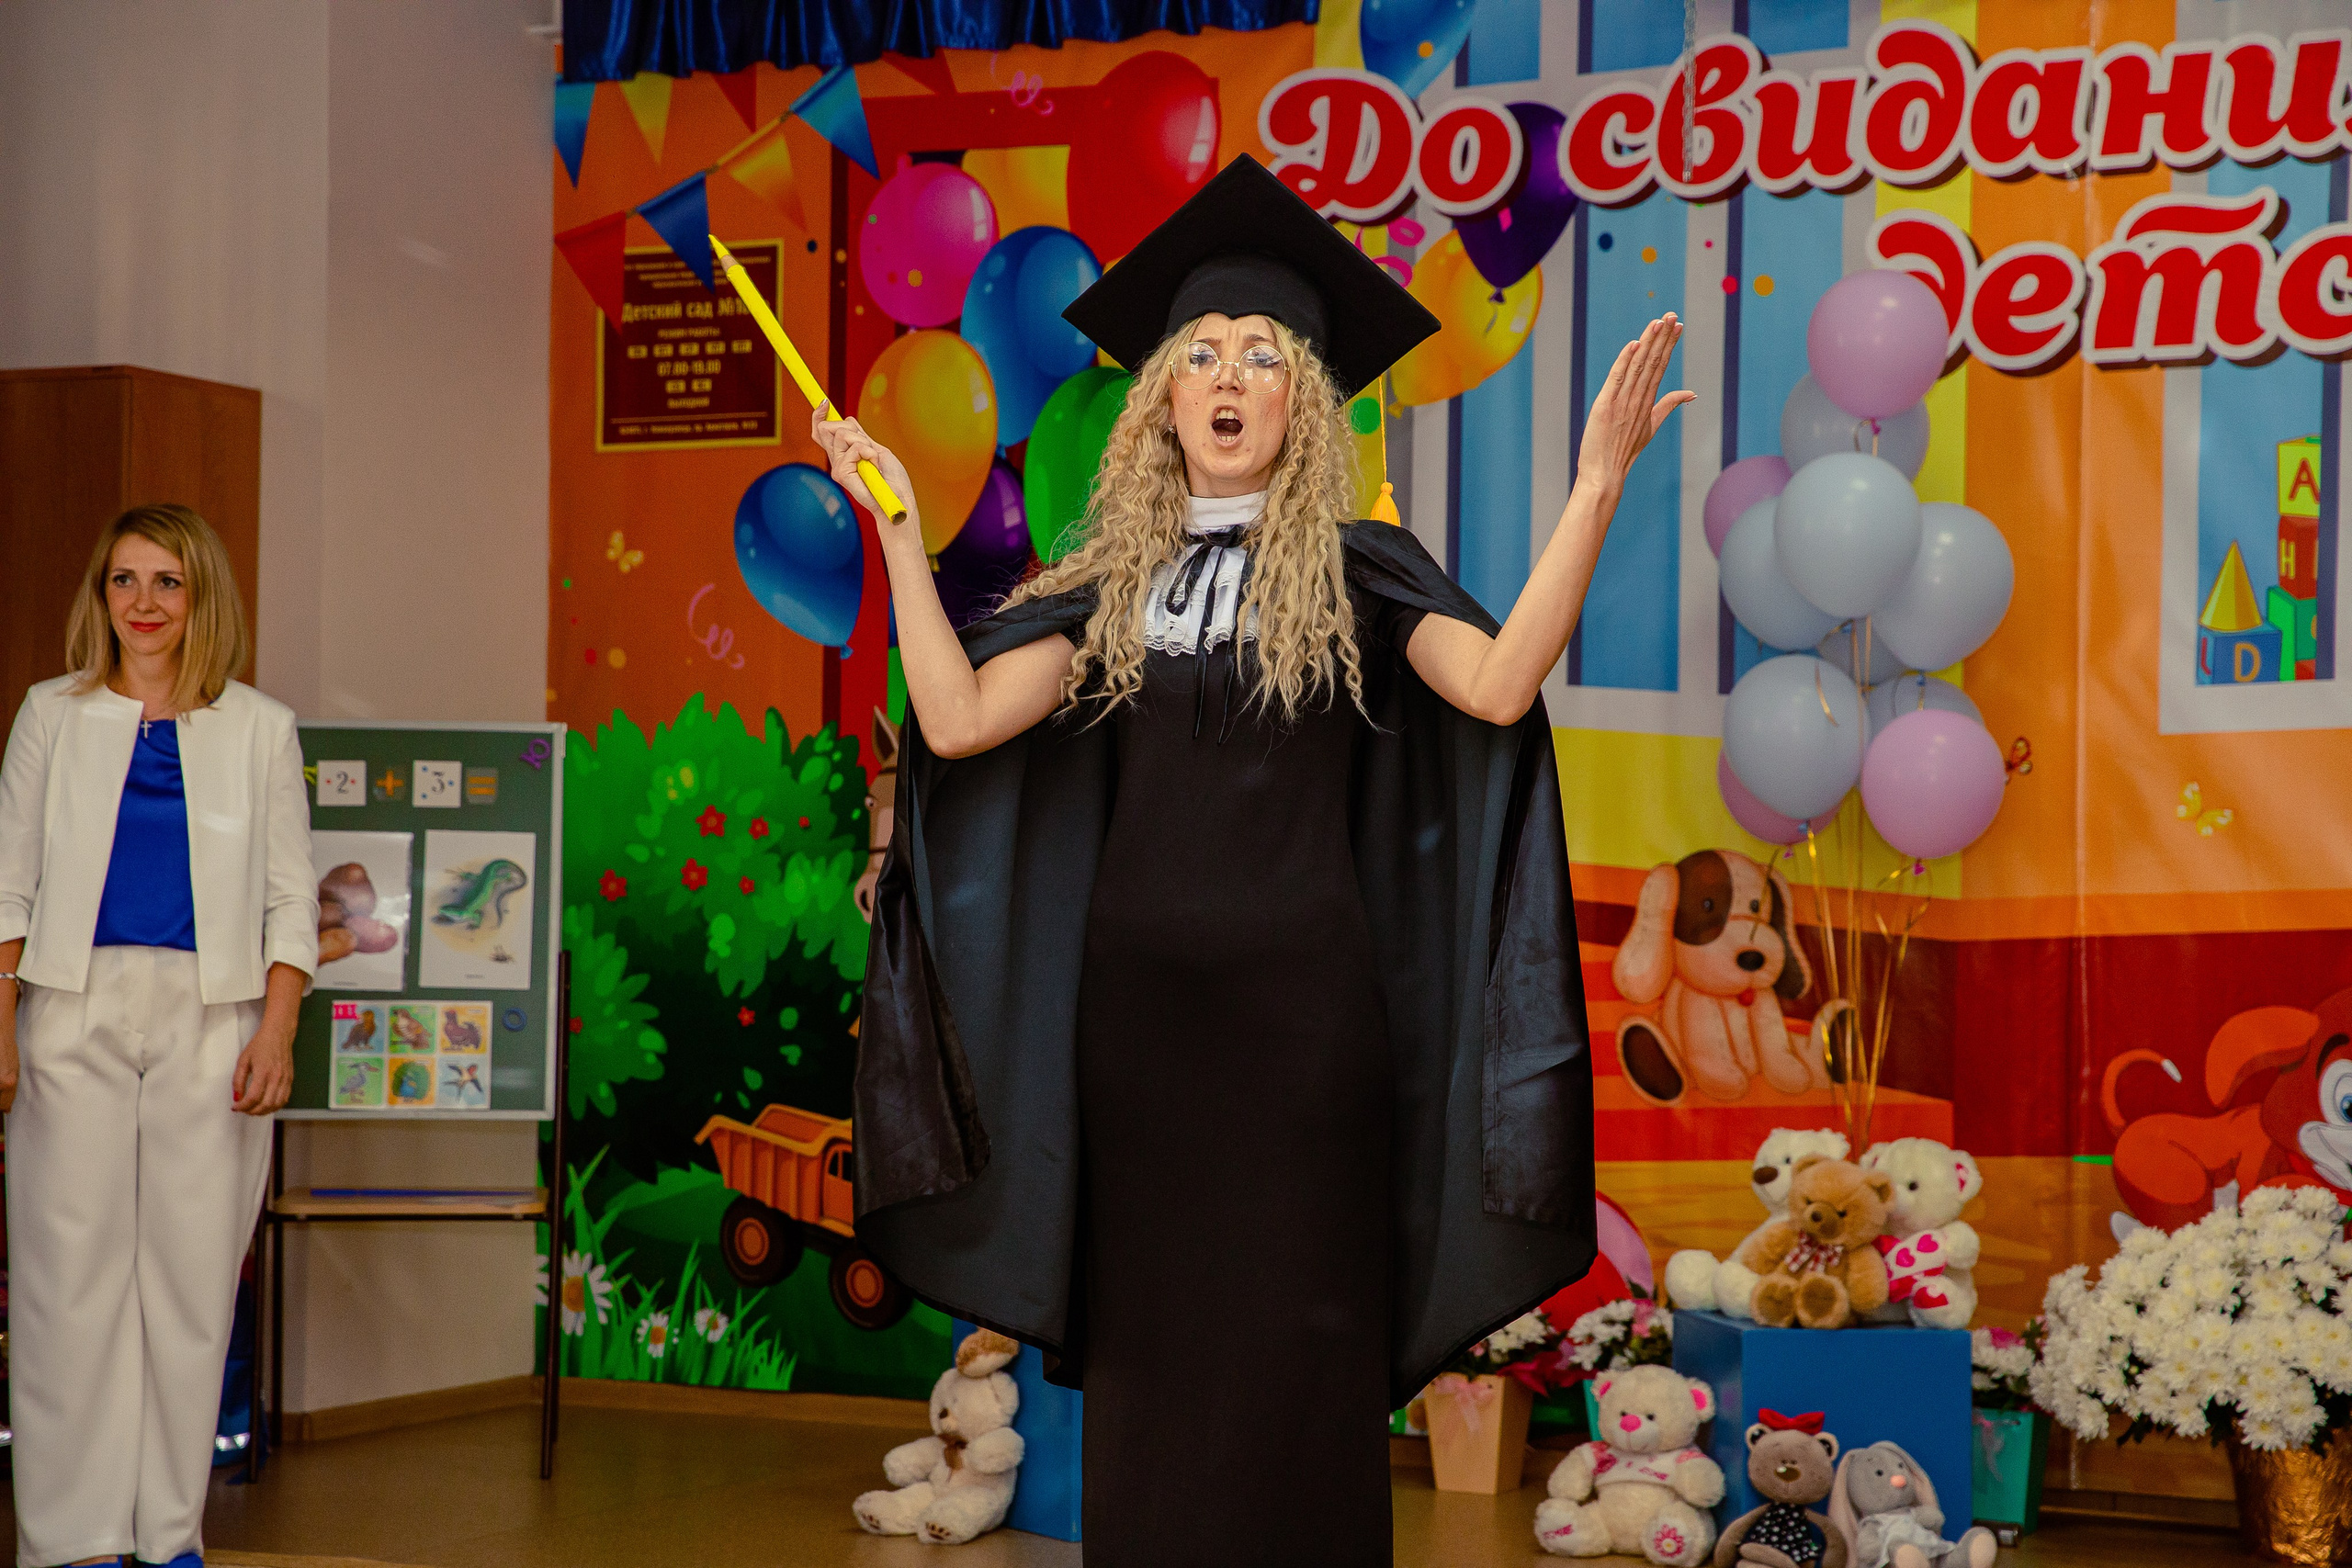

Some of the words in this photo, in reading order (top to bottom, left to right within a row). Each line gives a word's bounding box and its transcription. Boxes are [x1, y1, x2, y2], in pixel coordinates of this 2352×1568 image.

[1268, 77, 1511, 211] До
[1566, 28, 2352, 192] свидани
[622, 301, 682, 322] Детский
[685, 301, 714, 320] сад
[2288, 457, 2322, 504] A
[2233, 640, 2262, 682] D
[335, 770, 349, 795] 2
[431, 771, 446, 795] 3
